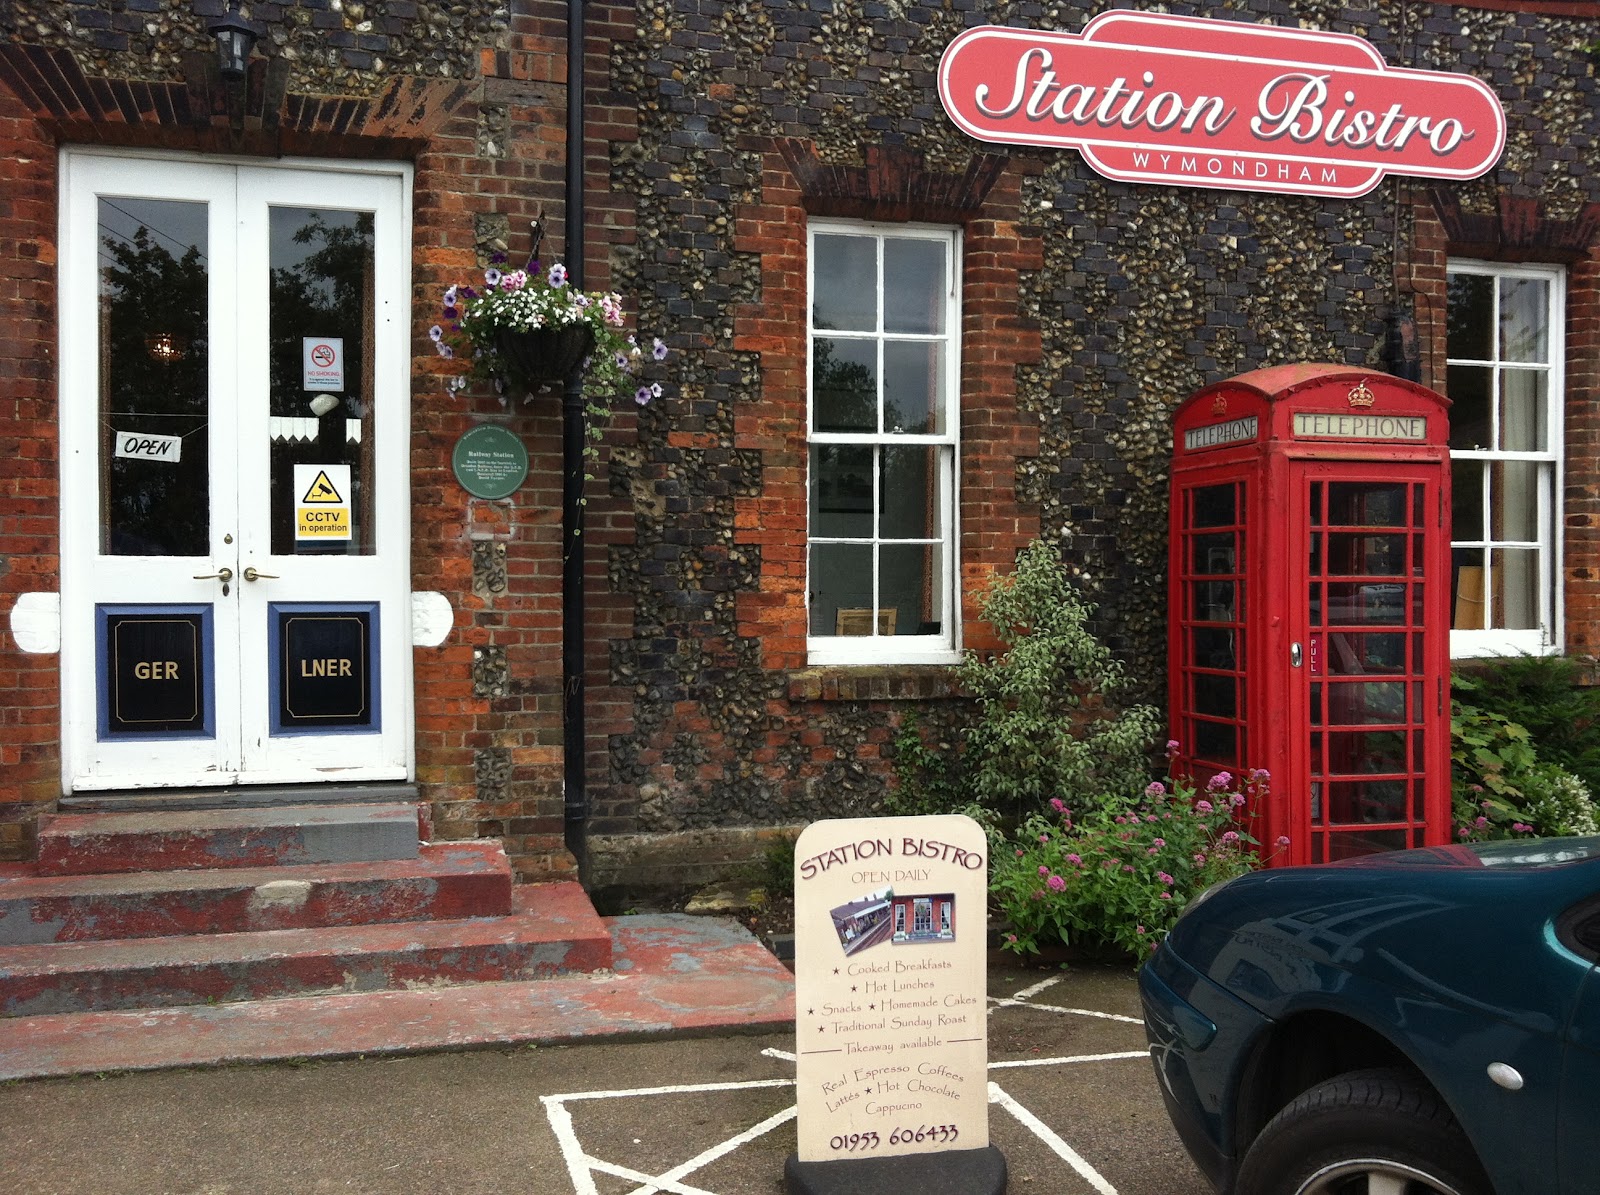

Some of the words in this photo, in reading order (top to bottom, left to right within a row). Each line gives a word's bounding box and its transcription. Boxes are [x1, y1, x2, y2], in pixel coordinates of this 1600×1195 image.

[974, 47, 1237, 136] Station
[1250, 72, 1476, 154] Bistro
[1133, 152, 1339, 184] WYMONDHAM
[1187, 417, 1257, 449] TELEPHONE
[1298, 415, 1421, 438] TELEPHONE
[124, 437, 173, 456] OPEN
[305, 511, 340, 522] CCTV
[299, 523, 307, 532] in
[308, 523, 348, 533] operation
[134, 661, 180, 680] GER
[301, 658, 352, 678] LNER
[799, 838, 893, 881] STATION
[902, 837, 983, 870] BISTRO
[851, 870, 890, 884] OPEN
[894, 868, 932, 882] DAILY
[847, 961, 890, 977] Cooked
[894, 958, 952, 974] Breakfasts
[865, 980, 887, 994] Hot
[893, 977, 935, 993] Lunches
[821, 1001, 862, 1017] Snacks
[881, 996, 939, 1012] Homemade
[943, 993, 977, 1008] Cakes
[831, 1018, 886, 1035] Traditional
[890, 1016, 932, 1030] Sunday
[937, 1013, 967, 1026] Roast
[844, 1041, 894, 1056] Takeaway
[899, 1035, 942, 1050] available
[821, 1073, 848, 1096] Real
[853, 1064, 910, 1083] Espresso
[917, 1062, 965, 1083] Coffees
[877, 1080, 900, 1094] Hot
[907, 1078, 961, 1101] Chocolate
[865, 1101, 923, 1117] Cappucino
[829, 1131, 881, 1152] 01953
[889, 1124, 960, 1146] 606433
